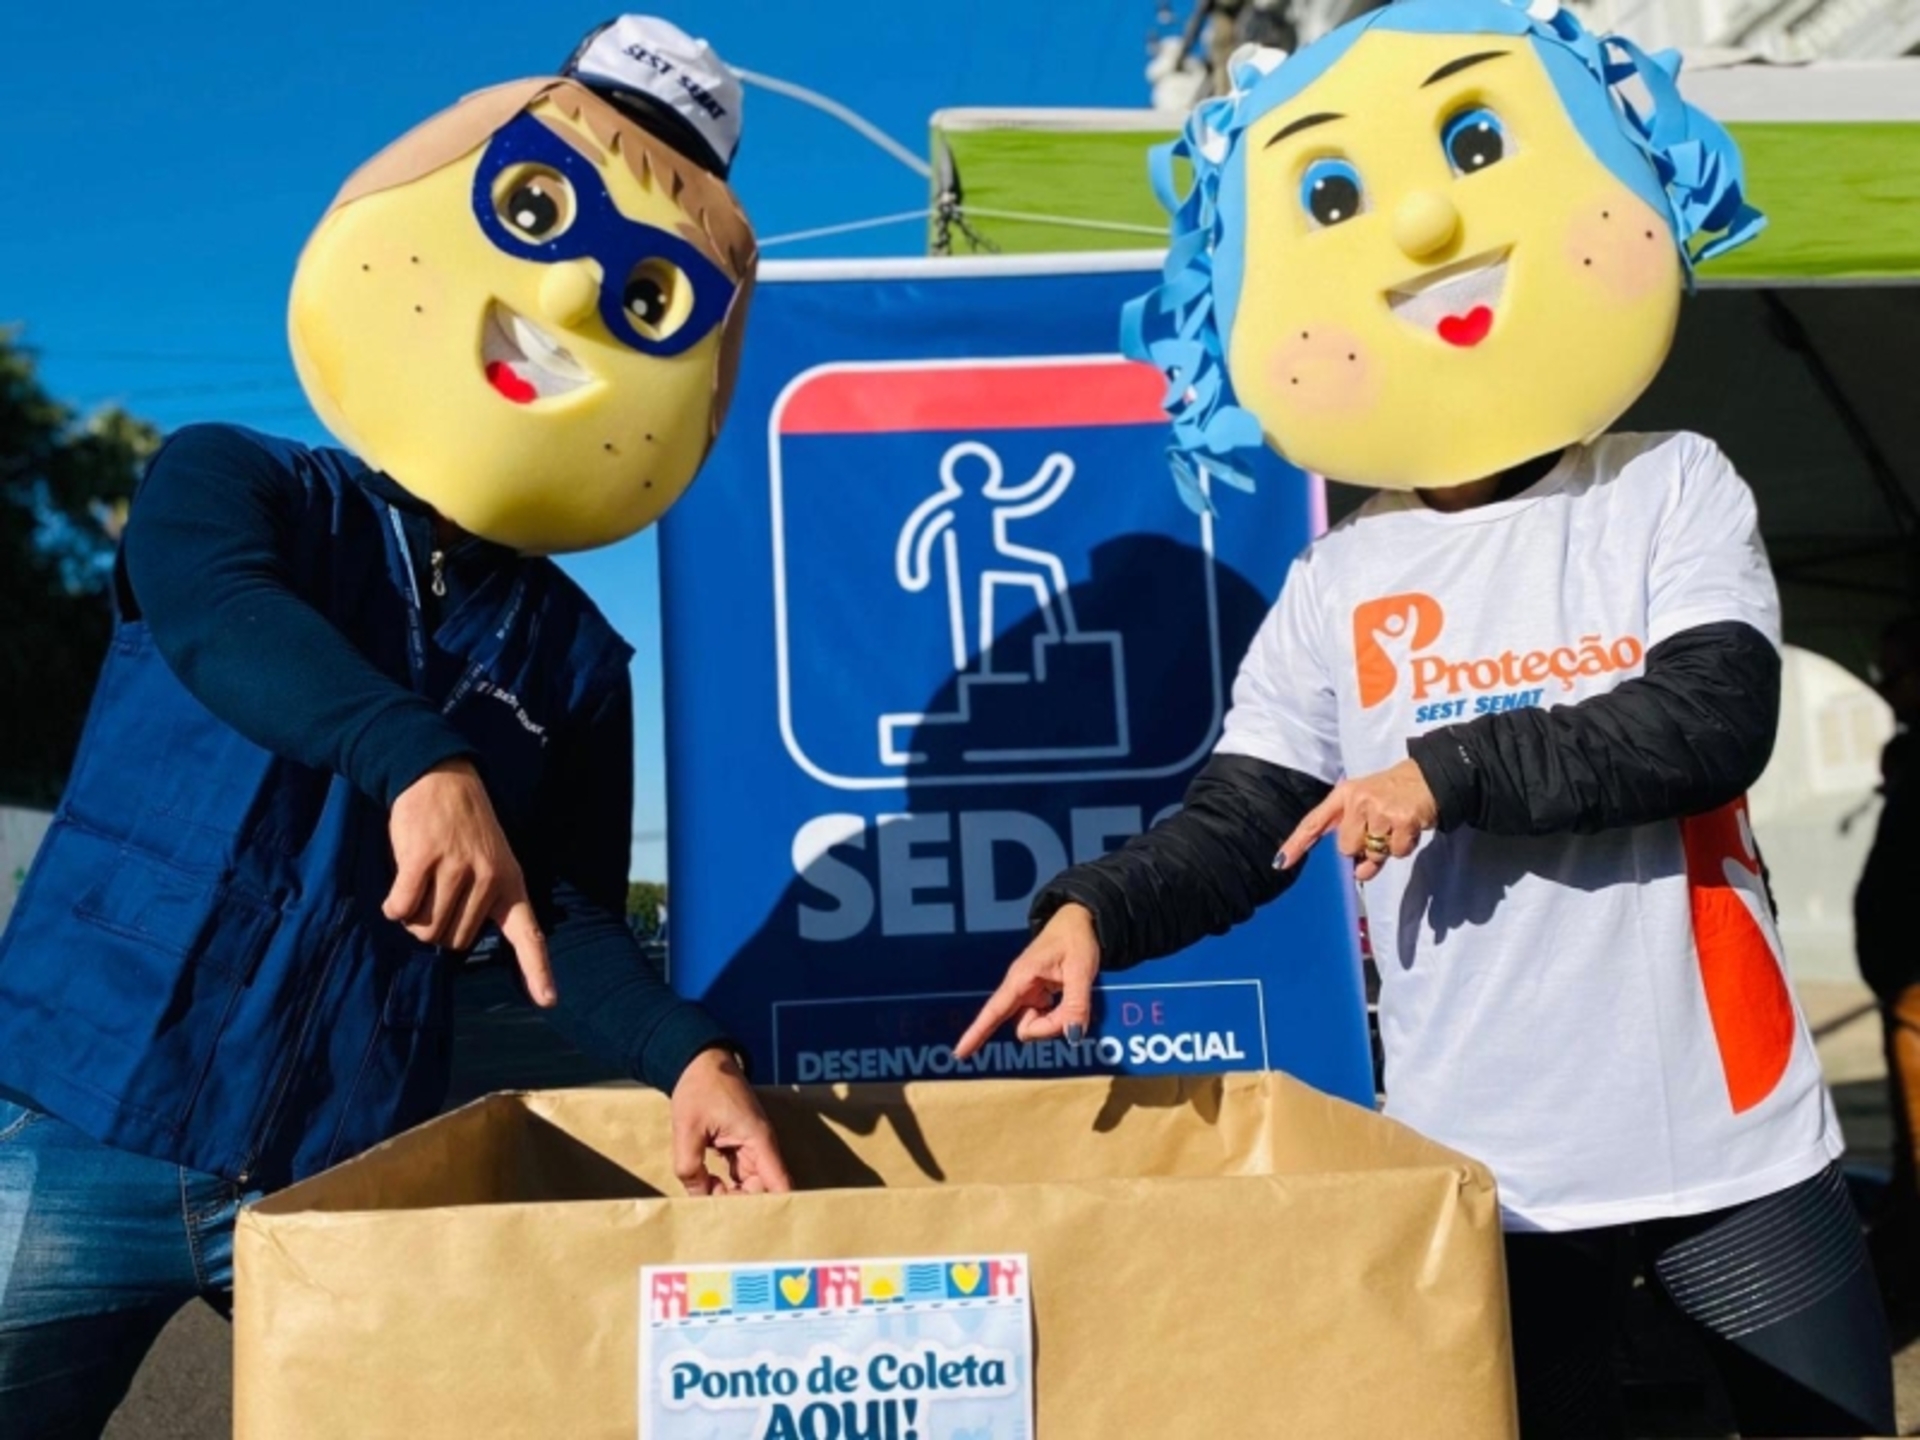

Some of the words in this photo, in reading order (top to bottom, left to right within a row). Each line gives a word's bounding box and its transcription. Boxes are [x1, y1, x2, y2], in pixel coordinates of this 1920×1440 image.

[623, 44, 673, 75] SEST
[1411, 635, 1642, 700] Proteção
[1415, 699, 1466, 724] SEST
[792, 803, 1185, 941] SEDE
[1121, 1002, 1166, 1027] DE
[1130, 1031, 1245, 1064] SOCIAL
[672, 1360, 798, 1400] Ponto
[807, 1355, 858, 1395] de
[867, 1351, 1007, 1392] Coleta
